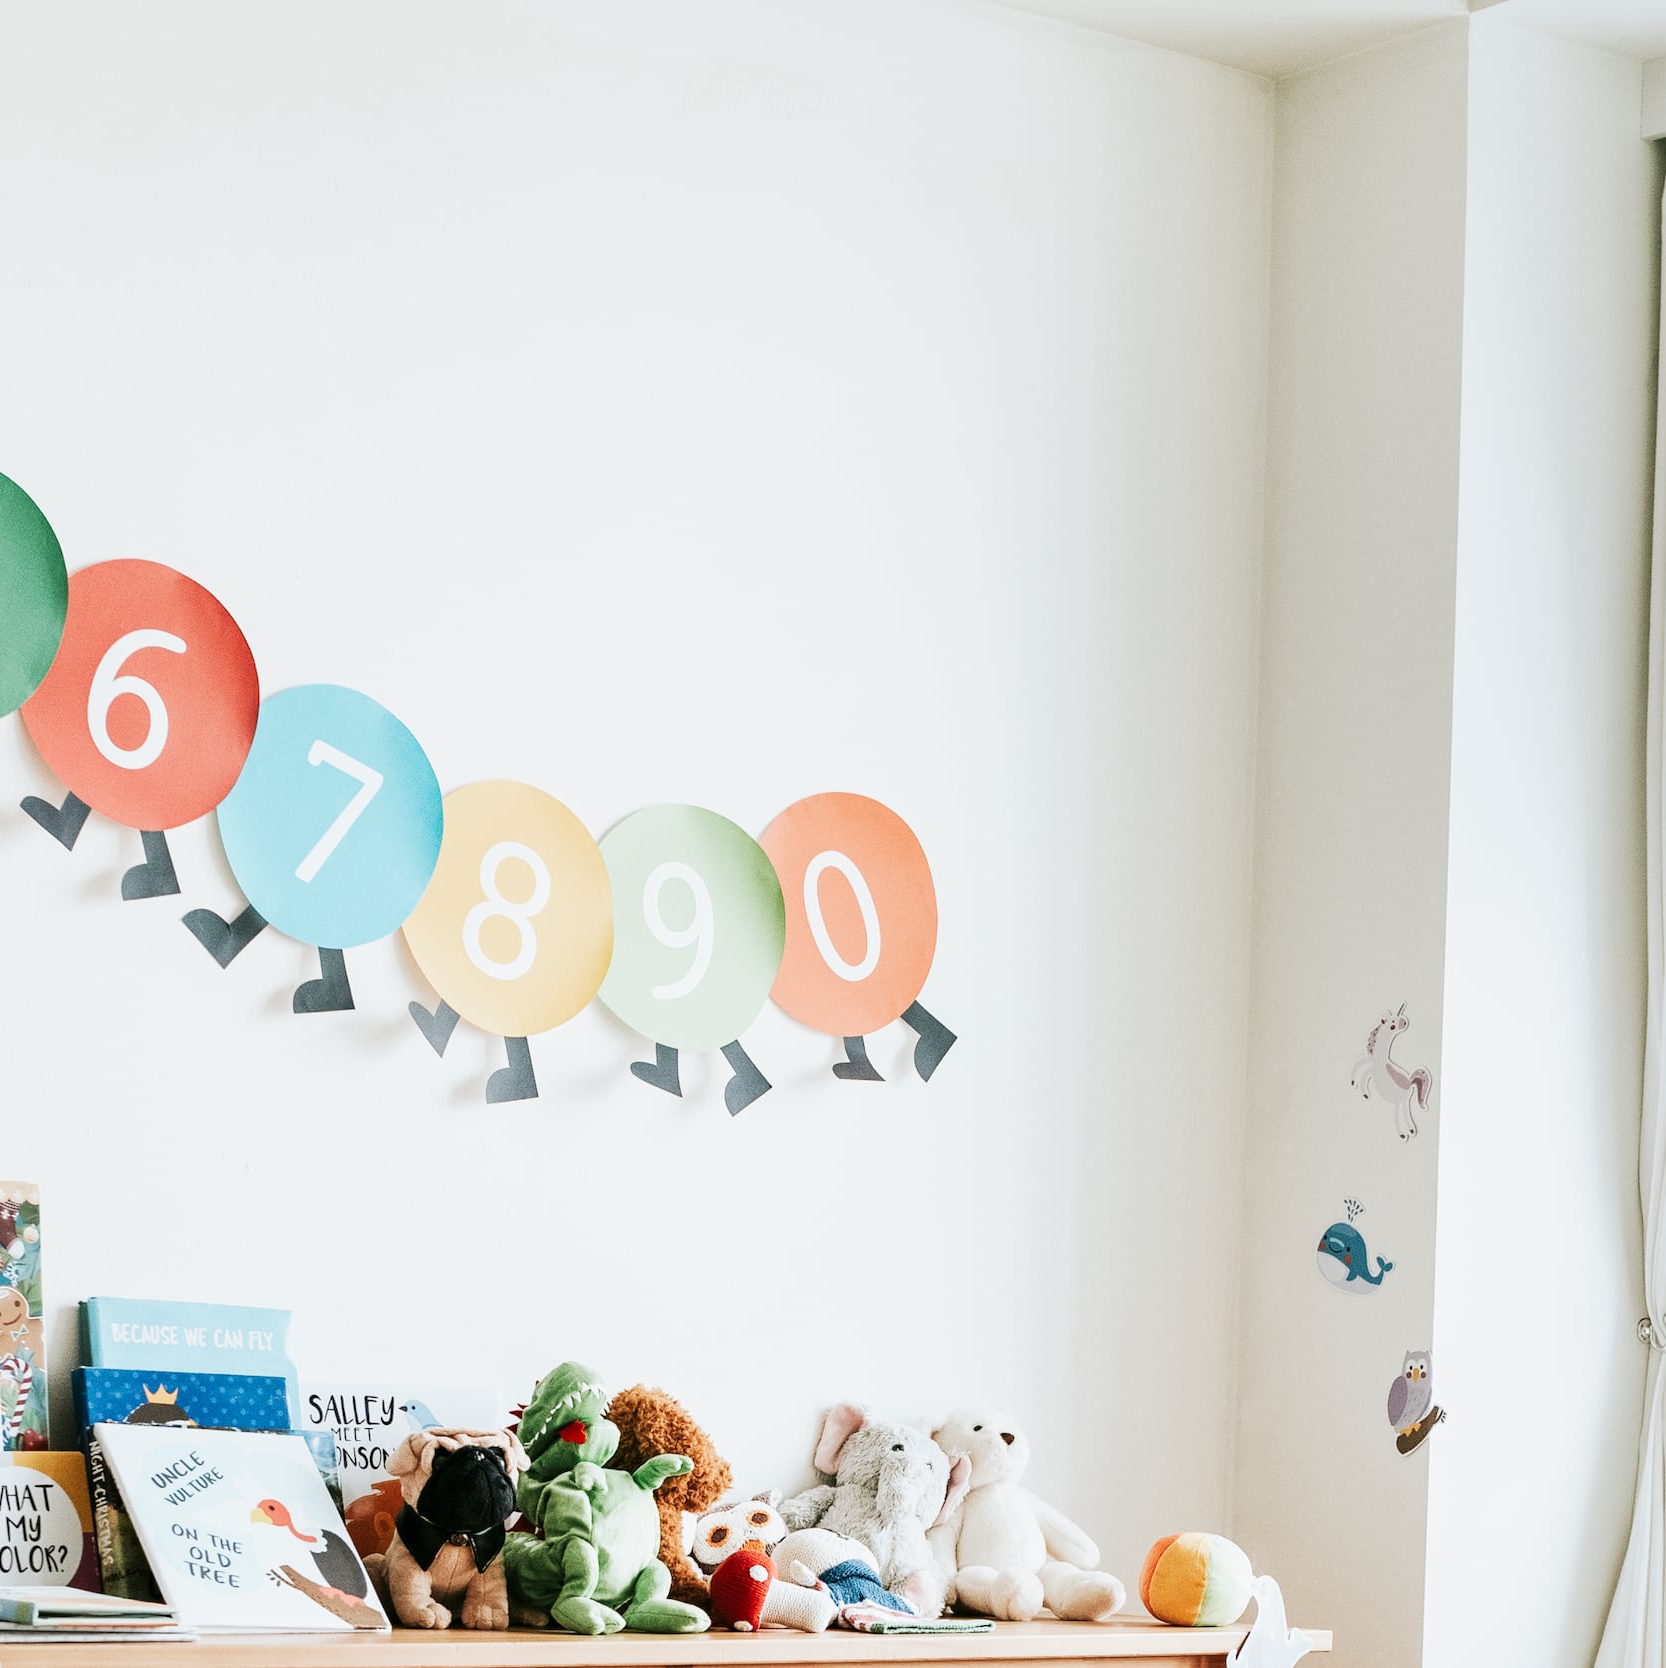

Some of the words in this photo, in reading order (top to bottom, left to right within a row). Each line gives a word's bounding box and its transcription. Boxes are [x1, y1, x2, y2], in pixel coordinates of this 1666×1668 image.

[87, 629, 187, 769] 6
[294, 739, 383, 883] 7
[462, 841, 551, 980] 8
[641, 861, 714, 999] 9
[803, 850, 881, 981] 0
[110, 1323, 179, 1345] BECAUSE
[184, 1328, 208, 1347] WE
[213, 1329, 244, 1349] CAN
[249, 1331, 275, 1351] FLY
[309, 1394, 394, 1426] SALLEY
[331, 1427, 373, 1442] MEET
[151, 1450, 205, 1489] UNCLE
[165, 1466, 224, 1506] VULTURE
[6, 1515, 41, 1542] MY
[171, 1523, 199, 1541] ON
[207, 1533, 243, 1554] THE
[189, 1546, 231, 1568] OLD
[184, 1560, 241, 1588] TREE
